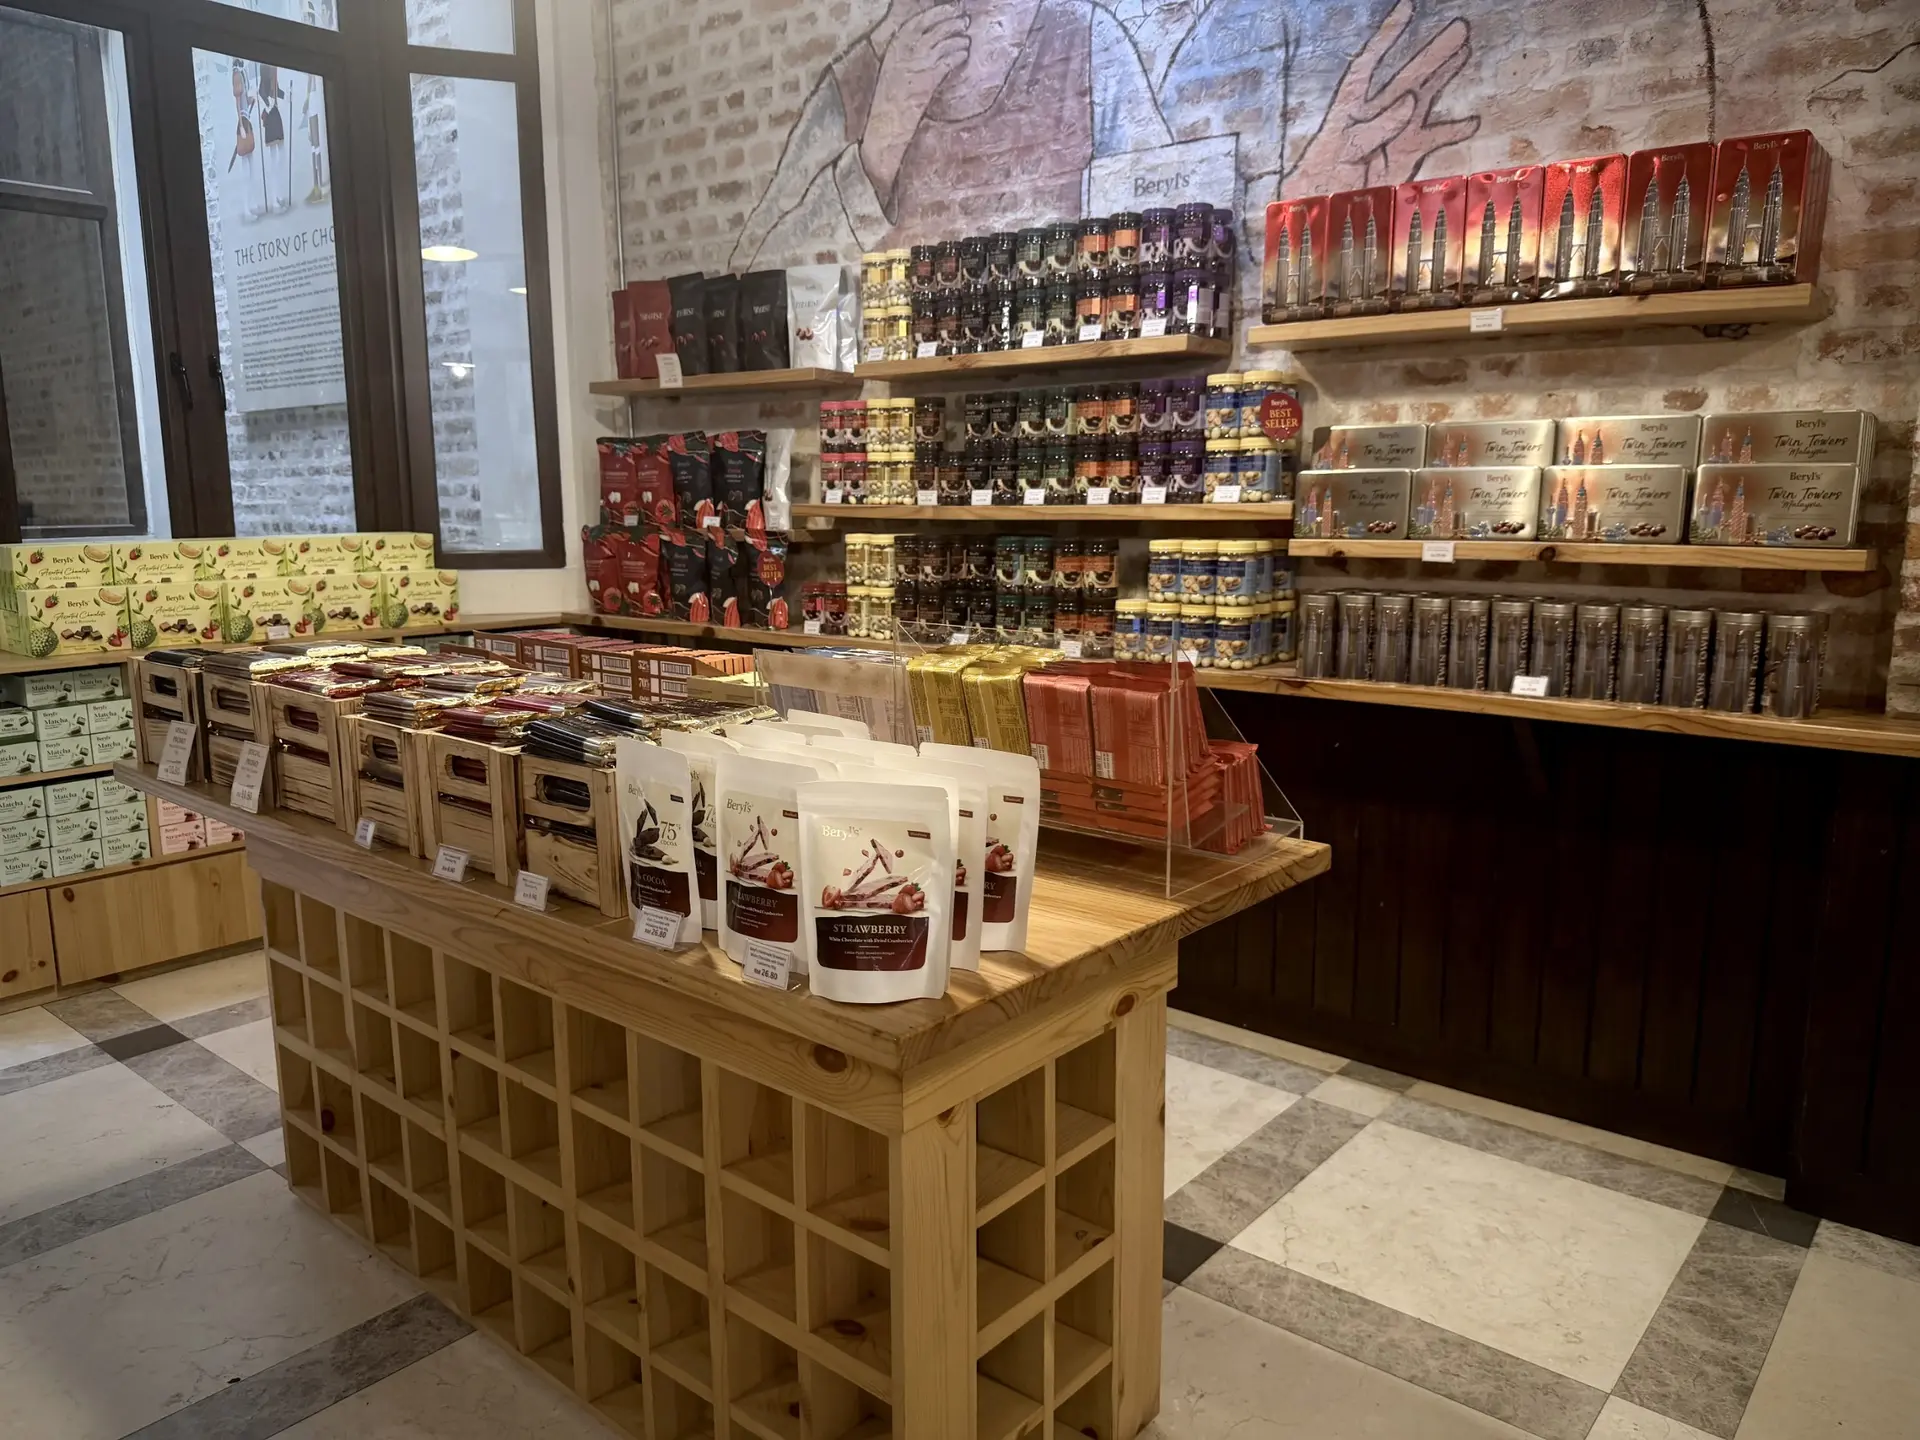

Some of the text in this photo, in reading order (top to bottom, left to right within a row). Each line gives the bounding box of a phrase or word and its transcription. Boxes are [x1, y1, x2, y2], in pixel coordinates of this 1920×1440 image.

[1134, 170, 1191, 197] Beryl's
[235, 245, 255, 267] THE
[258, 236, 290, 264] STORY
[293, 231, 308, 253] OF
[1269, 409, 1293, 419] BEST
[1265, 418, 1299, 429] SELLER
[1796, 420, 1827, 431] Beryl's
[1774, 433, 1848, 448] Twin Towers
[1789, 472, 1822, 483] Beryl's
[1768, 487, 1843, 501] Twin Towers
[53, 557, 74, 565] Beryl's
[67, 600, 89, 609] Beryl's
[726, 798, 751, 813] Beryl's
[822, 824, 860, 841] Beryl's
[651, 928, 667, 939] 26.80
[833, 923, 907, 935] STRAWBERRY
[761, 968, 778, 980] 26.80
